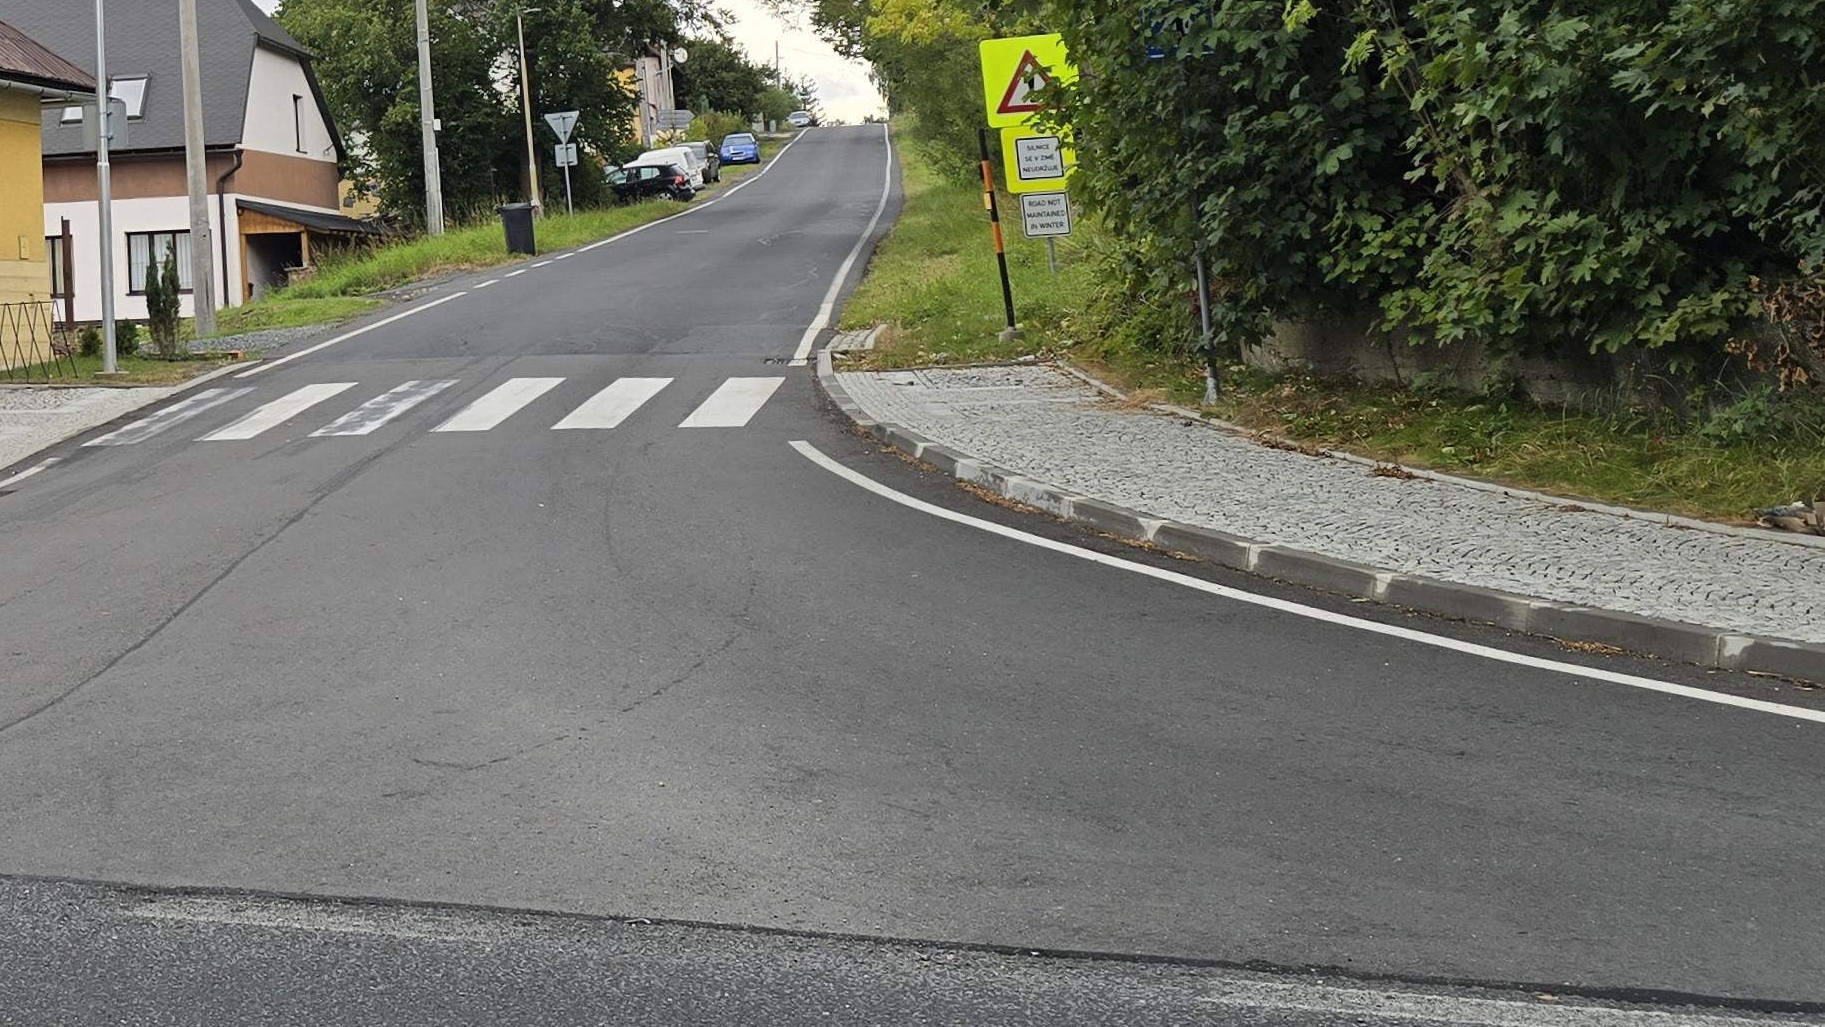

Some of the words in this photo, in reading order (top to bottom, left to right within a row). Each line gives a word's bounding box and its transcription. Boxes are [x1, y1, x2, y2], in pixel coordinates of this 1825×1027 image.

[1028, 199, 1046, 207] ROAD
[1047, 198, 1061, 206] NOT
[1026, 209, 1066, 218] MAINTAINED
[1039, 221, 1065, 229] WINTER
